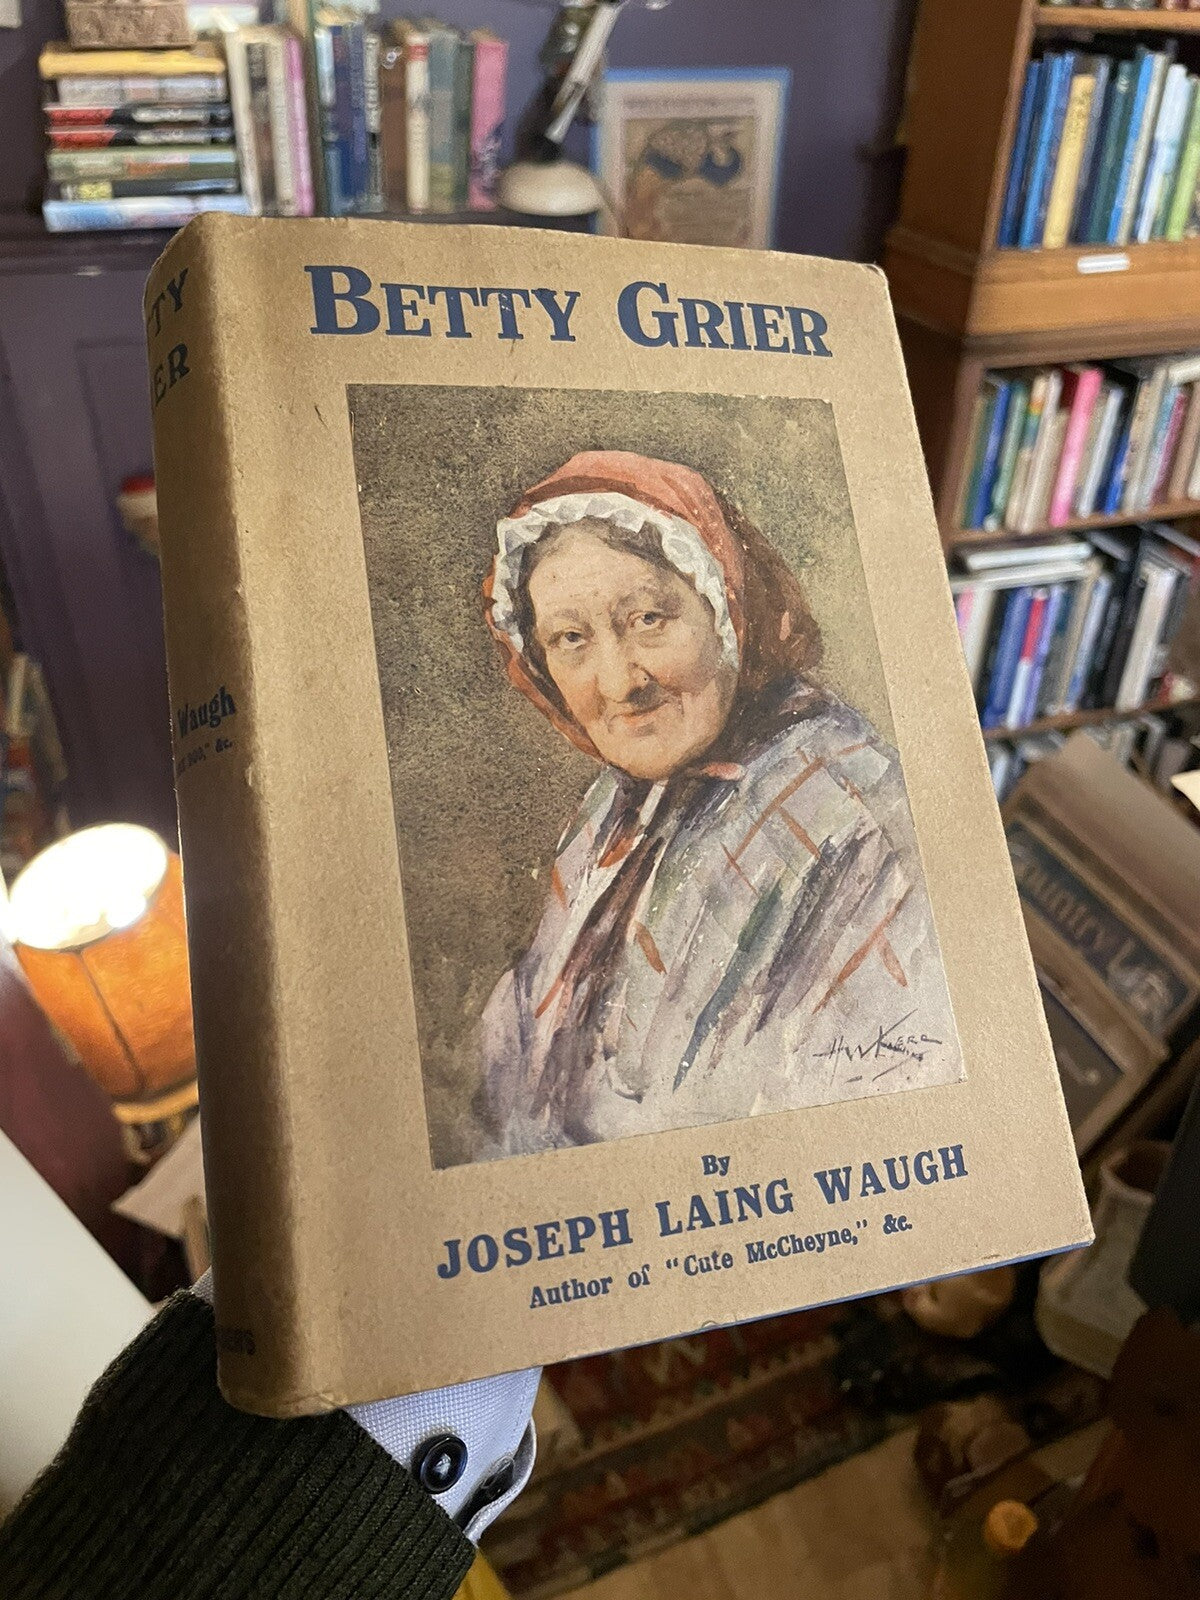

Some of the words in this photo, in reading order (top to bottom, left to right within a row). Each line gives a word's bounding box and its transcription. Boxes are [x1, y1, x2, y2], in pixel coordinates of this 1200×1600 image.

[304, 265, 581, 342] BETTY
[617, 281, 833, 357] GRIER
[177, 686, 236, 738] Waugh
[701, 1154, 731, 1177] By
[437, 1208, 634, 1280] JOSEPH
[655, 1178, 794, 1238] LAING
[813, 1144, 968, 1205] WAUGH
[529, 1276, 613, 1309] Author
[628, 1264, 650, 1288] of
[882, 1213, 913, 1235] &c.
